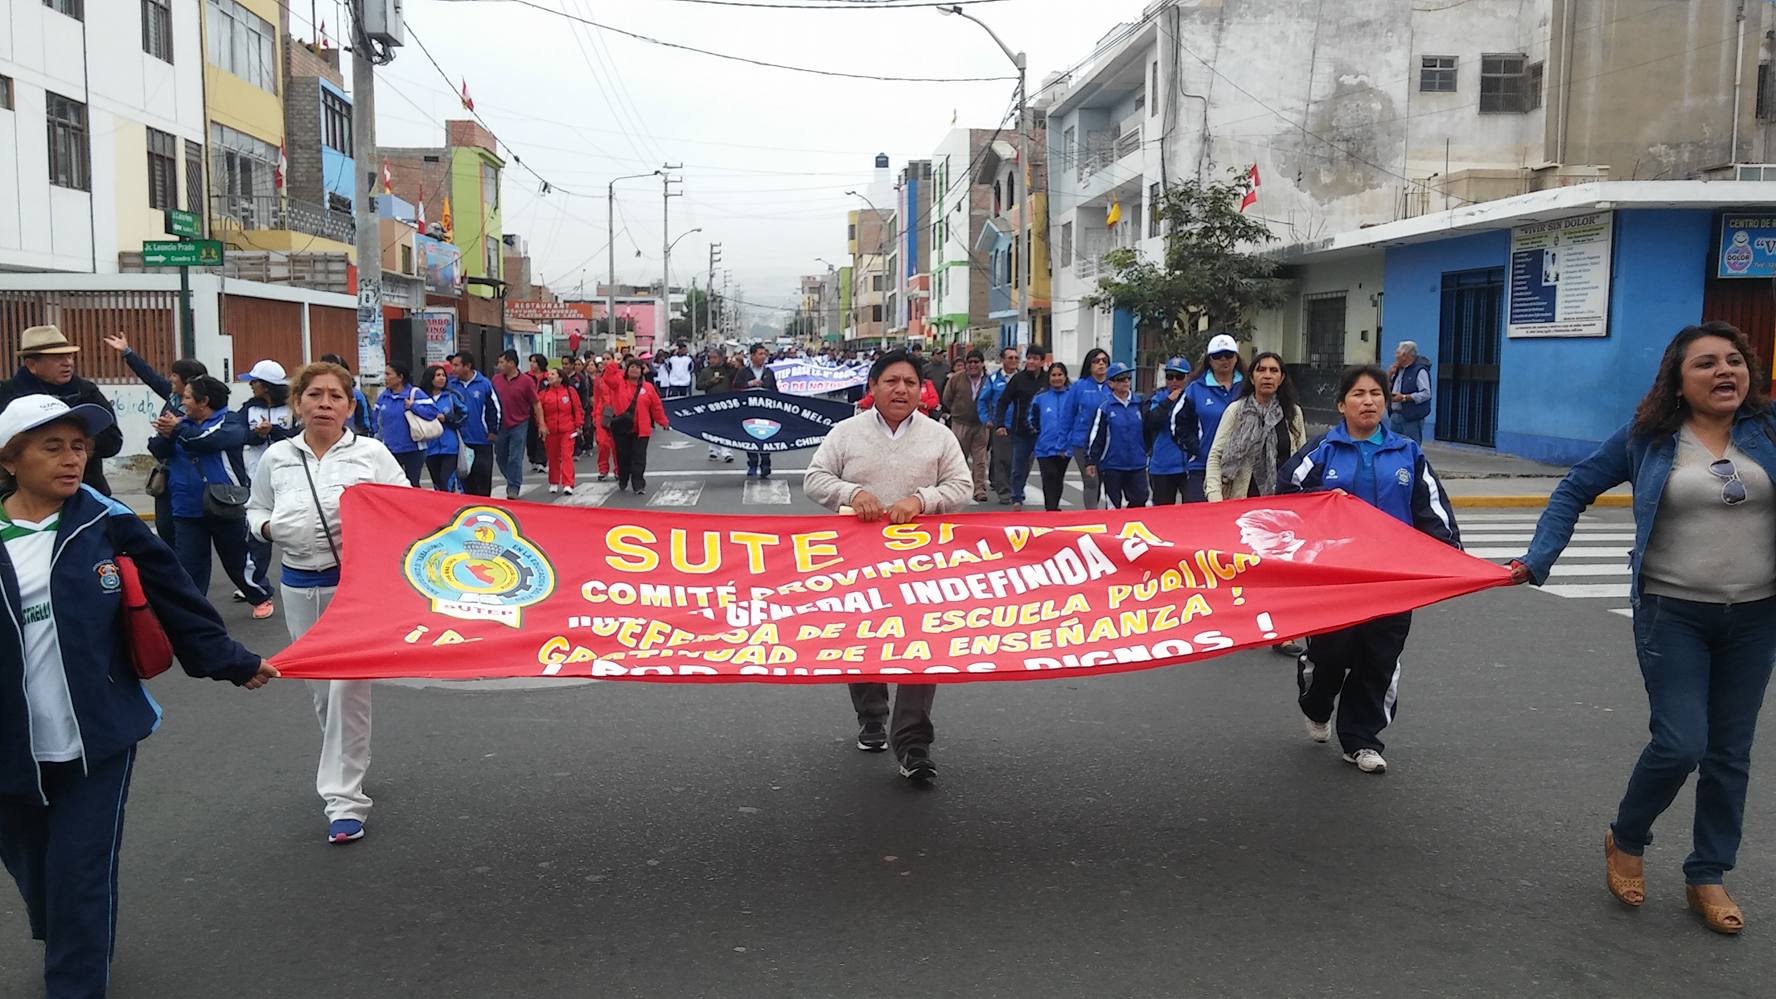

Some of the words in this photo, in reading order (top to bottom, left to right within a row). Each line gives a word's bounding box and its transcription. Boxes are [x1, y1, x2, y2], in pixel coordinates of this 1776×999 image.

[1729, 218, 1759, 229] CENTRO
[1760, 218, 1771, 228] DE
[153, 243, 176, 251] Leoncio
[177, 243, 195, 251] Prado
[748, 396, 800, 414] MARIANO
[701, 432, 758, 450] ESPERANZA
[762, 441, 788, 450] ALTA
[604, 524, 844, 574] SUTE
[898, 533, 1118, 605] INDEFINIDA
[581, 580, 736, 608] COMITÉ
[796, 623, 847, 641] DE
[856, 616, 906, 639] LA
[921, 593, 1092, 634] ESCUELA
[815, 645, 868, 662] DE
[880, 640, 932, 661] LA
[948, 593, 1213, 657] ENSEÑANZA
